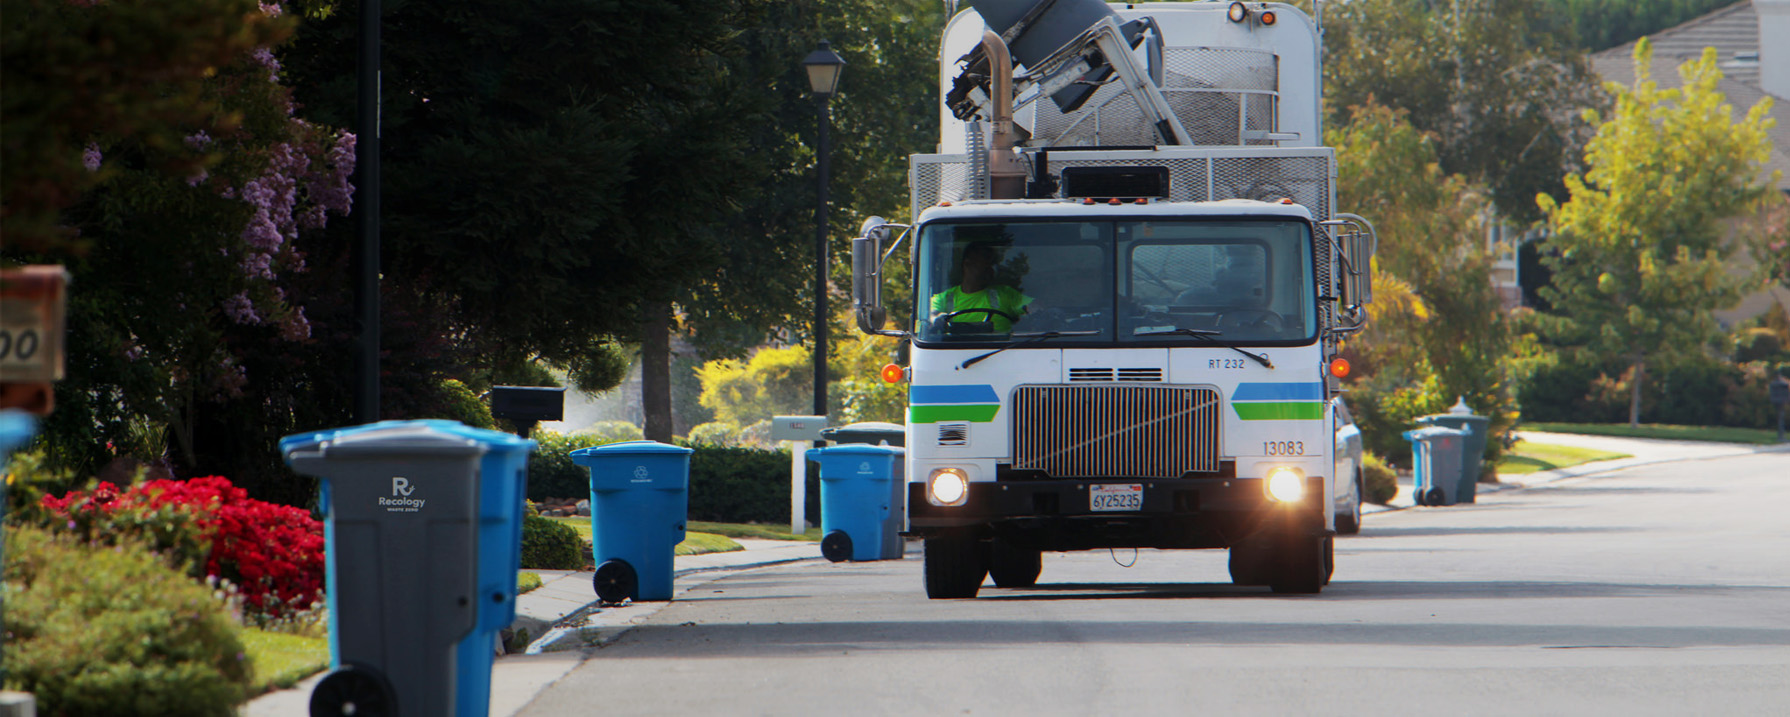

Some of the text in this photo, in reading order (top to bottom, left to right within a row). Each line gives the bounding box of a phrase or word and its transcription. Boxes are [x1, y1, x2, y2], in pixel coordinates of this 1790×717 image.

[1208, 359, 1245, 369] RT 232
[1263, 440, 1305, 456] 13083
[378, 496, 426, 508] Recology
[1093, 494, 1140, 508] 6Y25235
